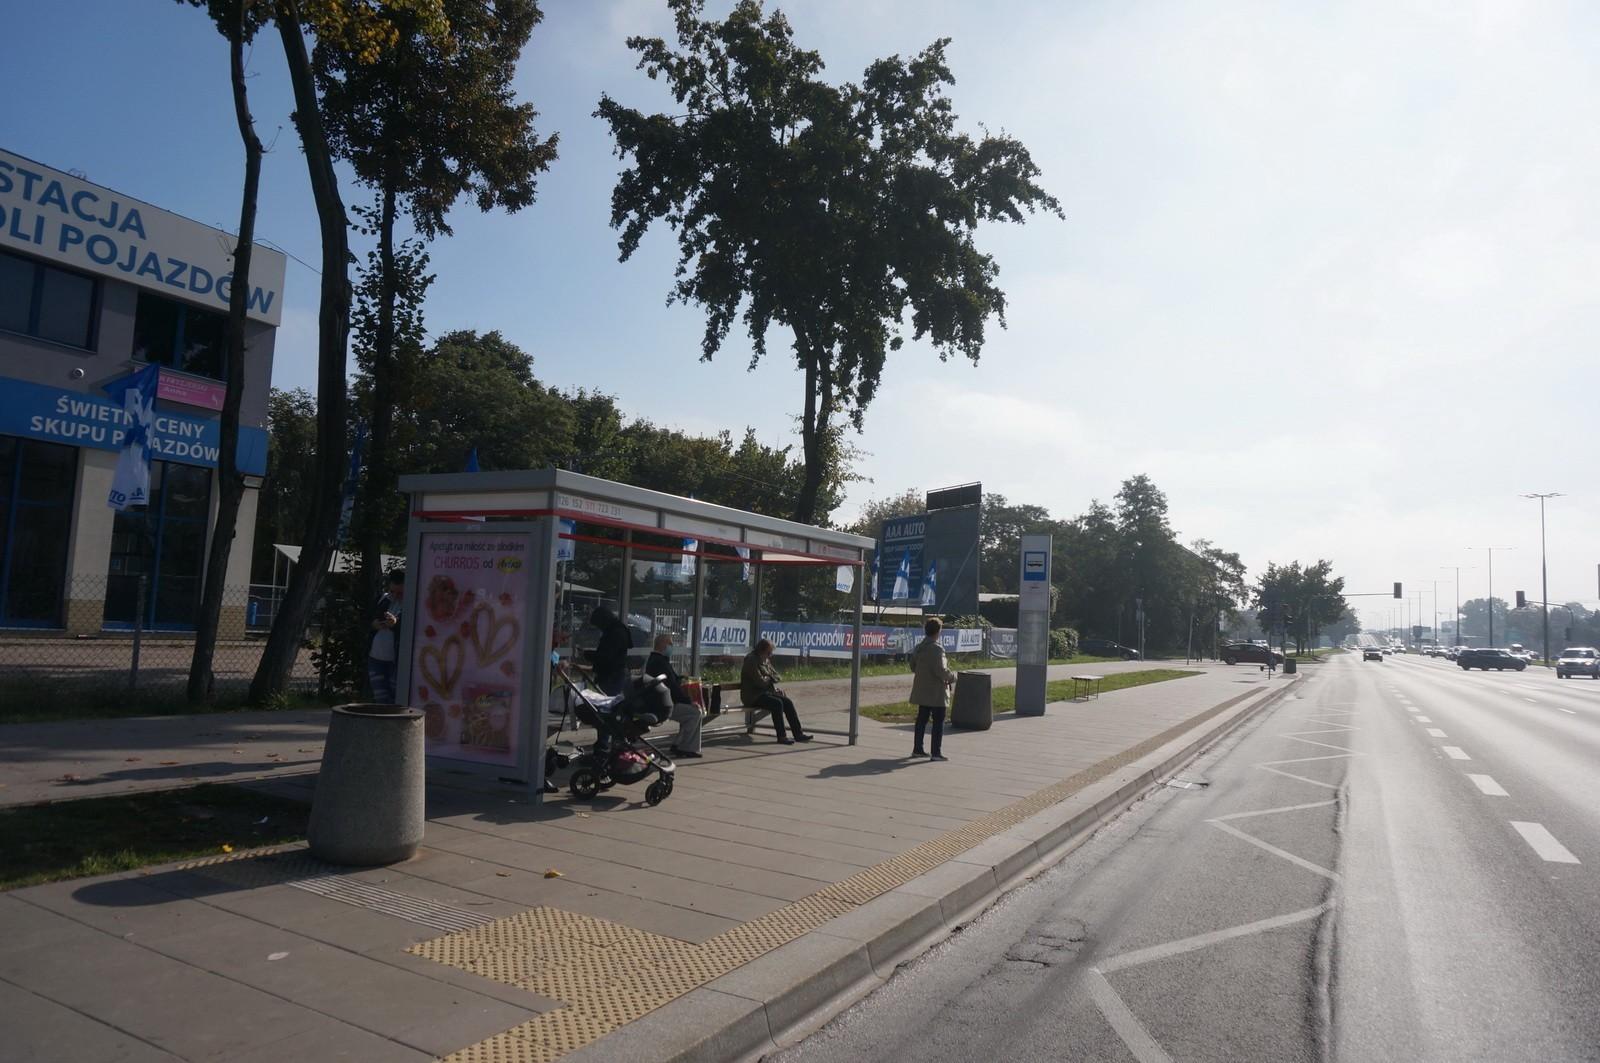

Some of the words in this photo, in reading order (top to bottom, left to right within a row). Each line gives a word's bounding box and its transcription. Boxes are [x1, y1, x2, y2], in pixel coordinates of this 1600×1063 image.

[0, 160, 146, 240] STACJA
[0, 203, 44, 245] LI
[56, 395, 134, 425] ŚWIETN
[155, 417, 205, 440] CENY
[30, 415, 106, 442] SKUPU
[112, 430, 220, 462] PAZDÓW
[886, 525, 902, 537] AAA
[903, 521, 925, 536] AUTO
[433, 556, 480, 570] CHURROS
[482, 558, 494, 569] od
[701, 625, 718, 642] AA
[719, 626, 747, 643] AUTO
[761, 630, 785, 646] SKUP
[787, 629, 845, 647] SAMOCHODÓW
[860, 632, 886, 649] OTÓWKĘ
